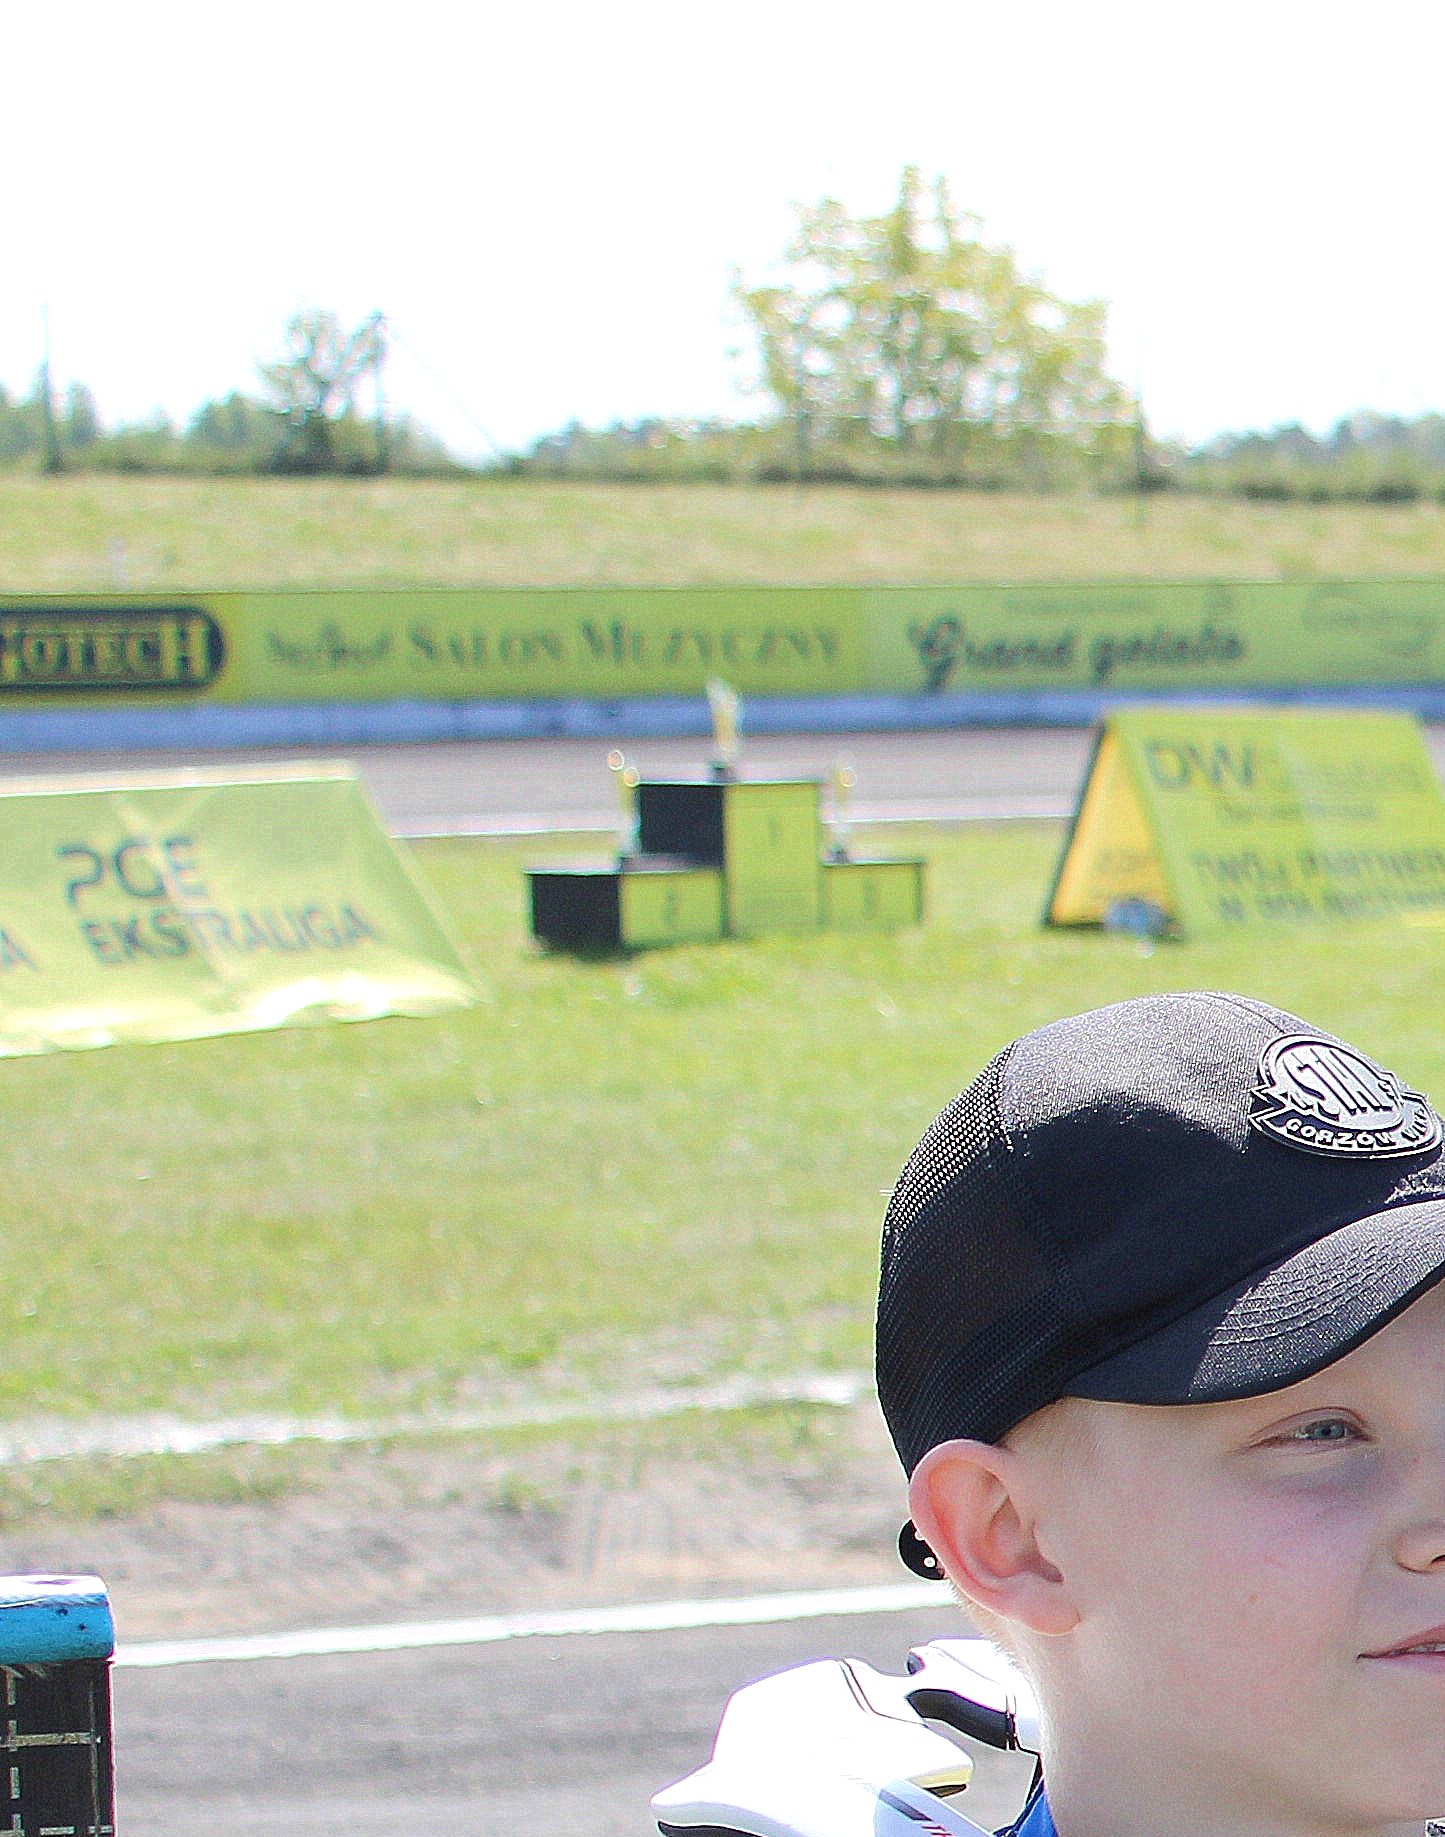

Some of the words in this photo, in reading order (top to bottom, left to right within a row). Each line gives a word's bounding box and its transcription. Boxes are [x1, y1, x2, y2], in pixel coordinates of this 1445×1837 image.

[908, 613, 1076, 696] Grand
[57, 836, 209, 907] PGE
[80, 902, 382, 965] EKSTRALIGA
[1285, 1117, 1395, 1149] GORZÓW
